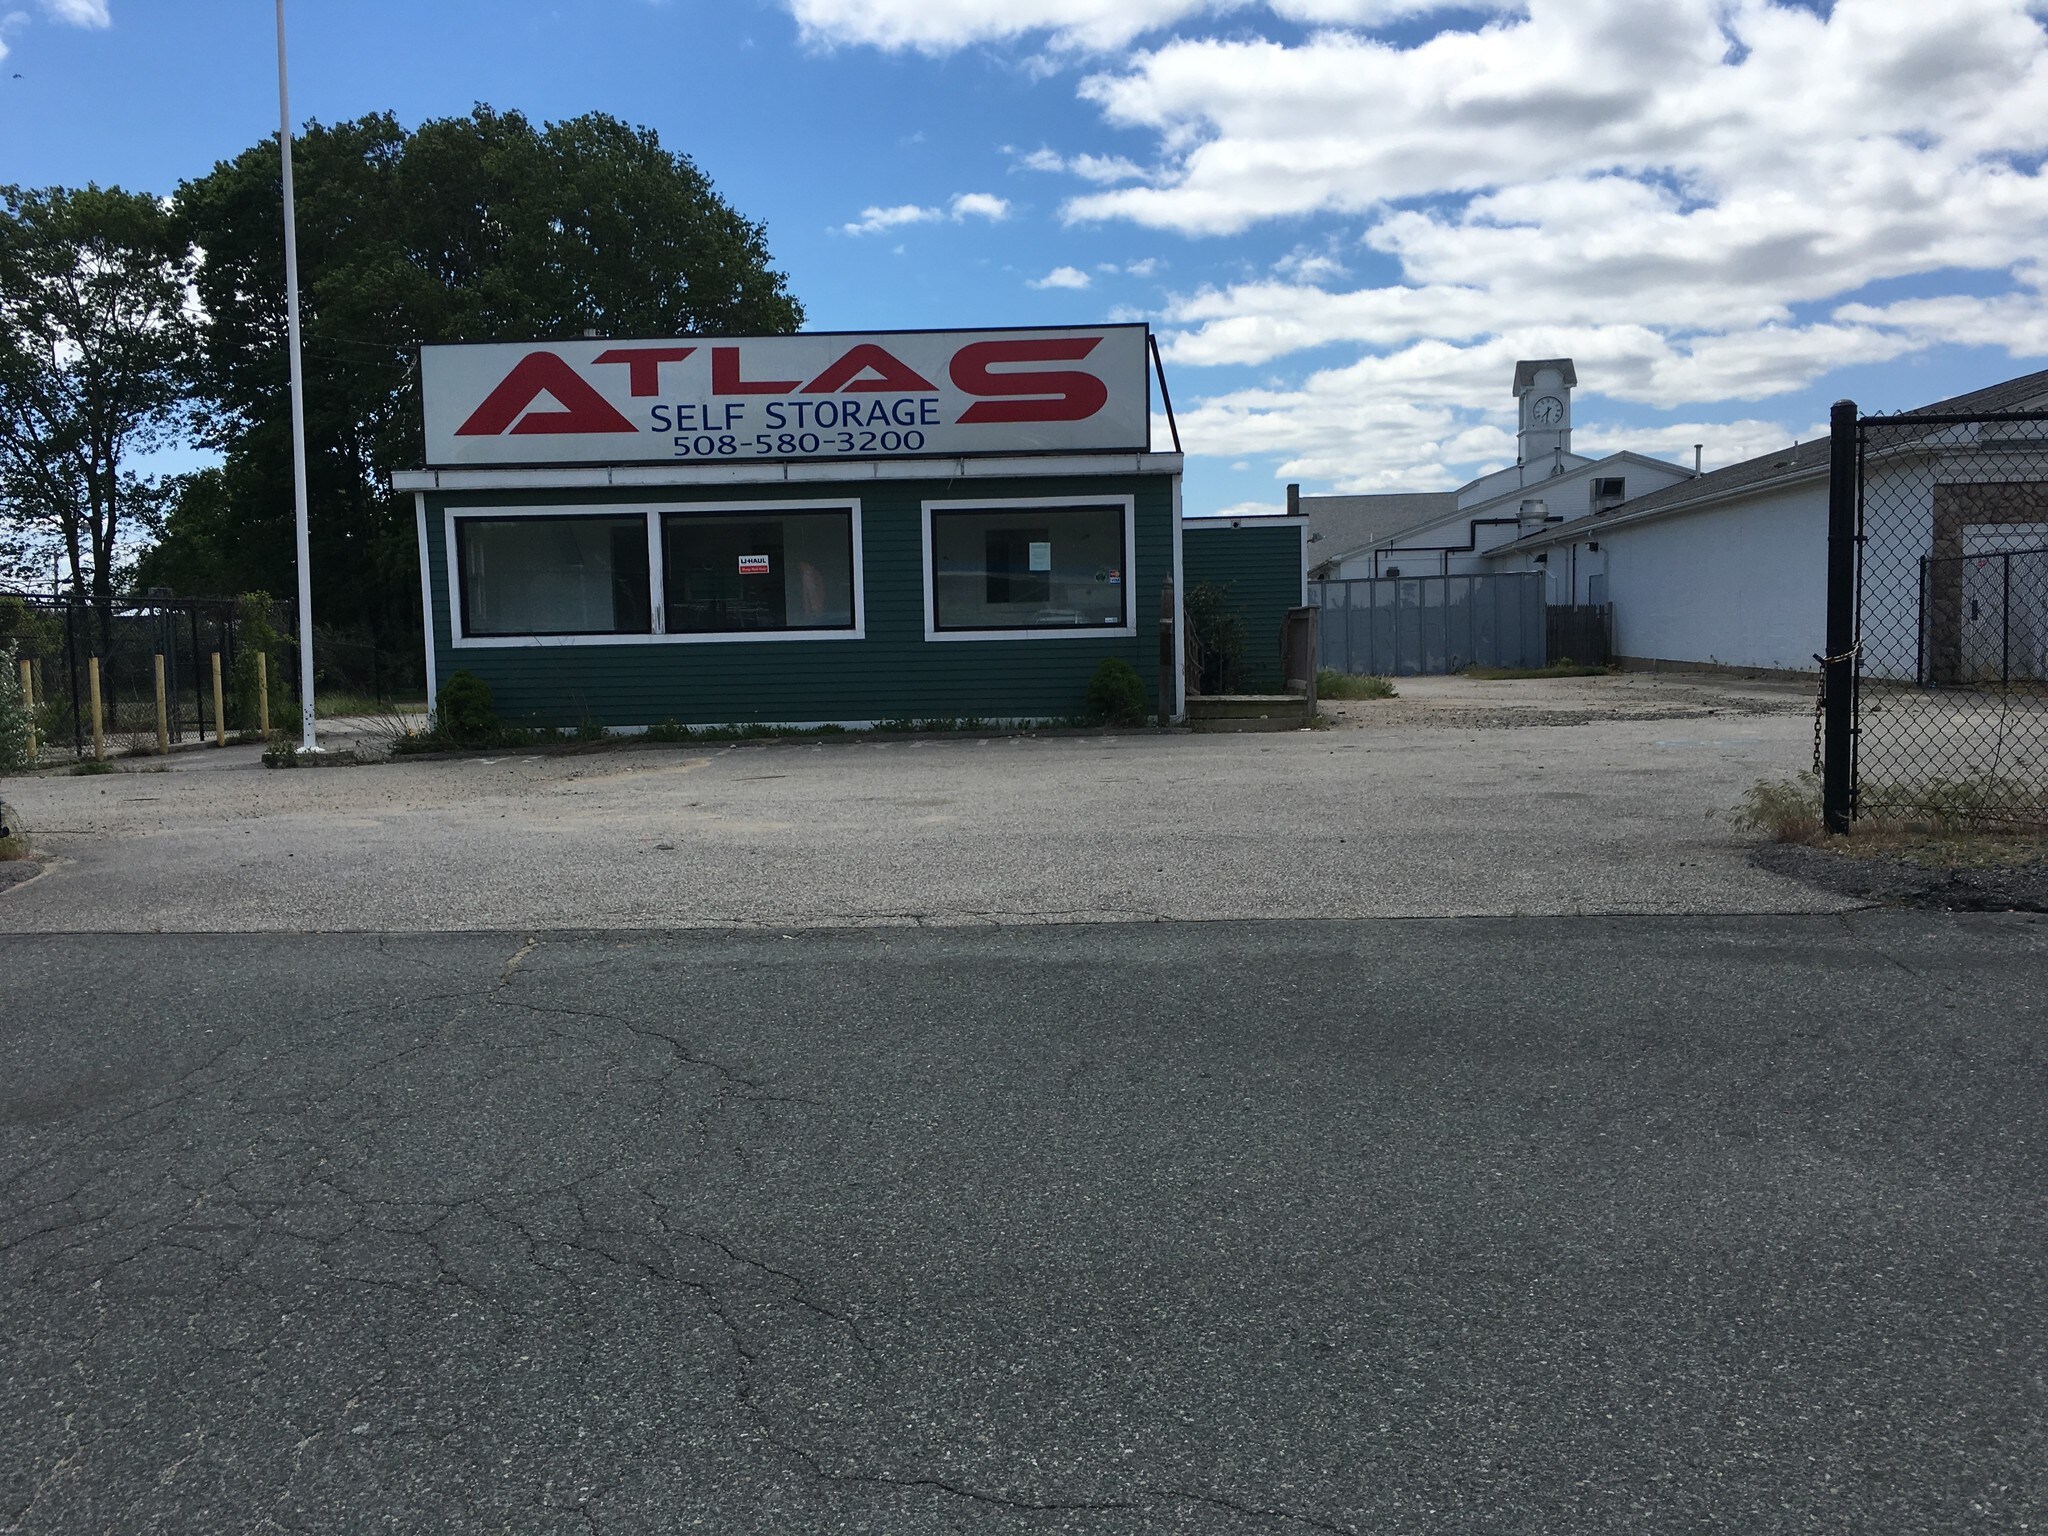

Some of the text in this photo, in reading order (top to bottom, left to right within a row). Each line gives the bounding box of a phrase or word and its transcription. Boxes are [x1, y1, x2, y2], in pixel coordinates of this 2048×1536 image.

[455, 337, 1108, 436] ATLAS
[651, 398, 940, 432] SELF STORAGE
[674, 429, 925, 457] 508-580-3200
